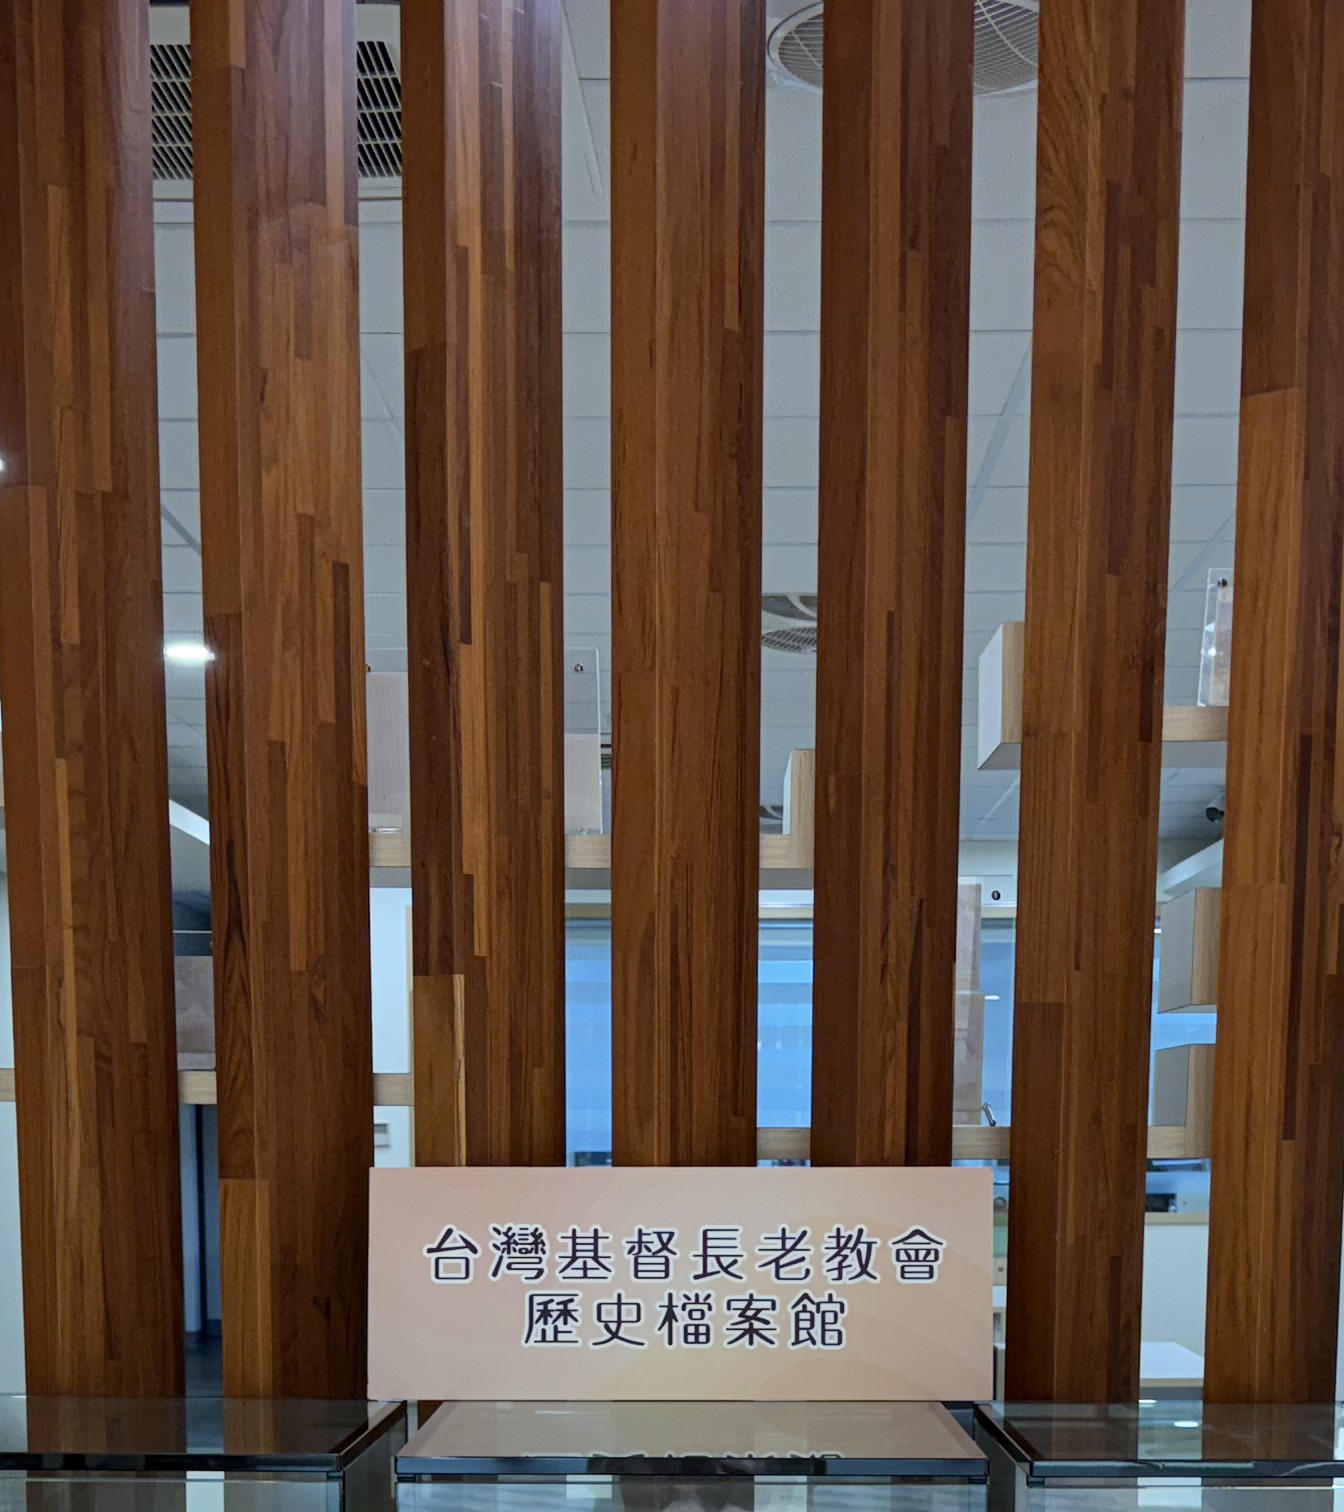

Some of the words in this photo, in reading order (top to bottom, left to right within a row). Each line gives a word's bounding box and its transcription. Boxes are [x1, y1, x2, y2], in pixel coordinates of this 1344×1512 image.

[425, 1224, 945, 1283] 台灣基督長老教會
[522, 1291, 846, 1349] 歷史檔案館
